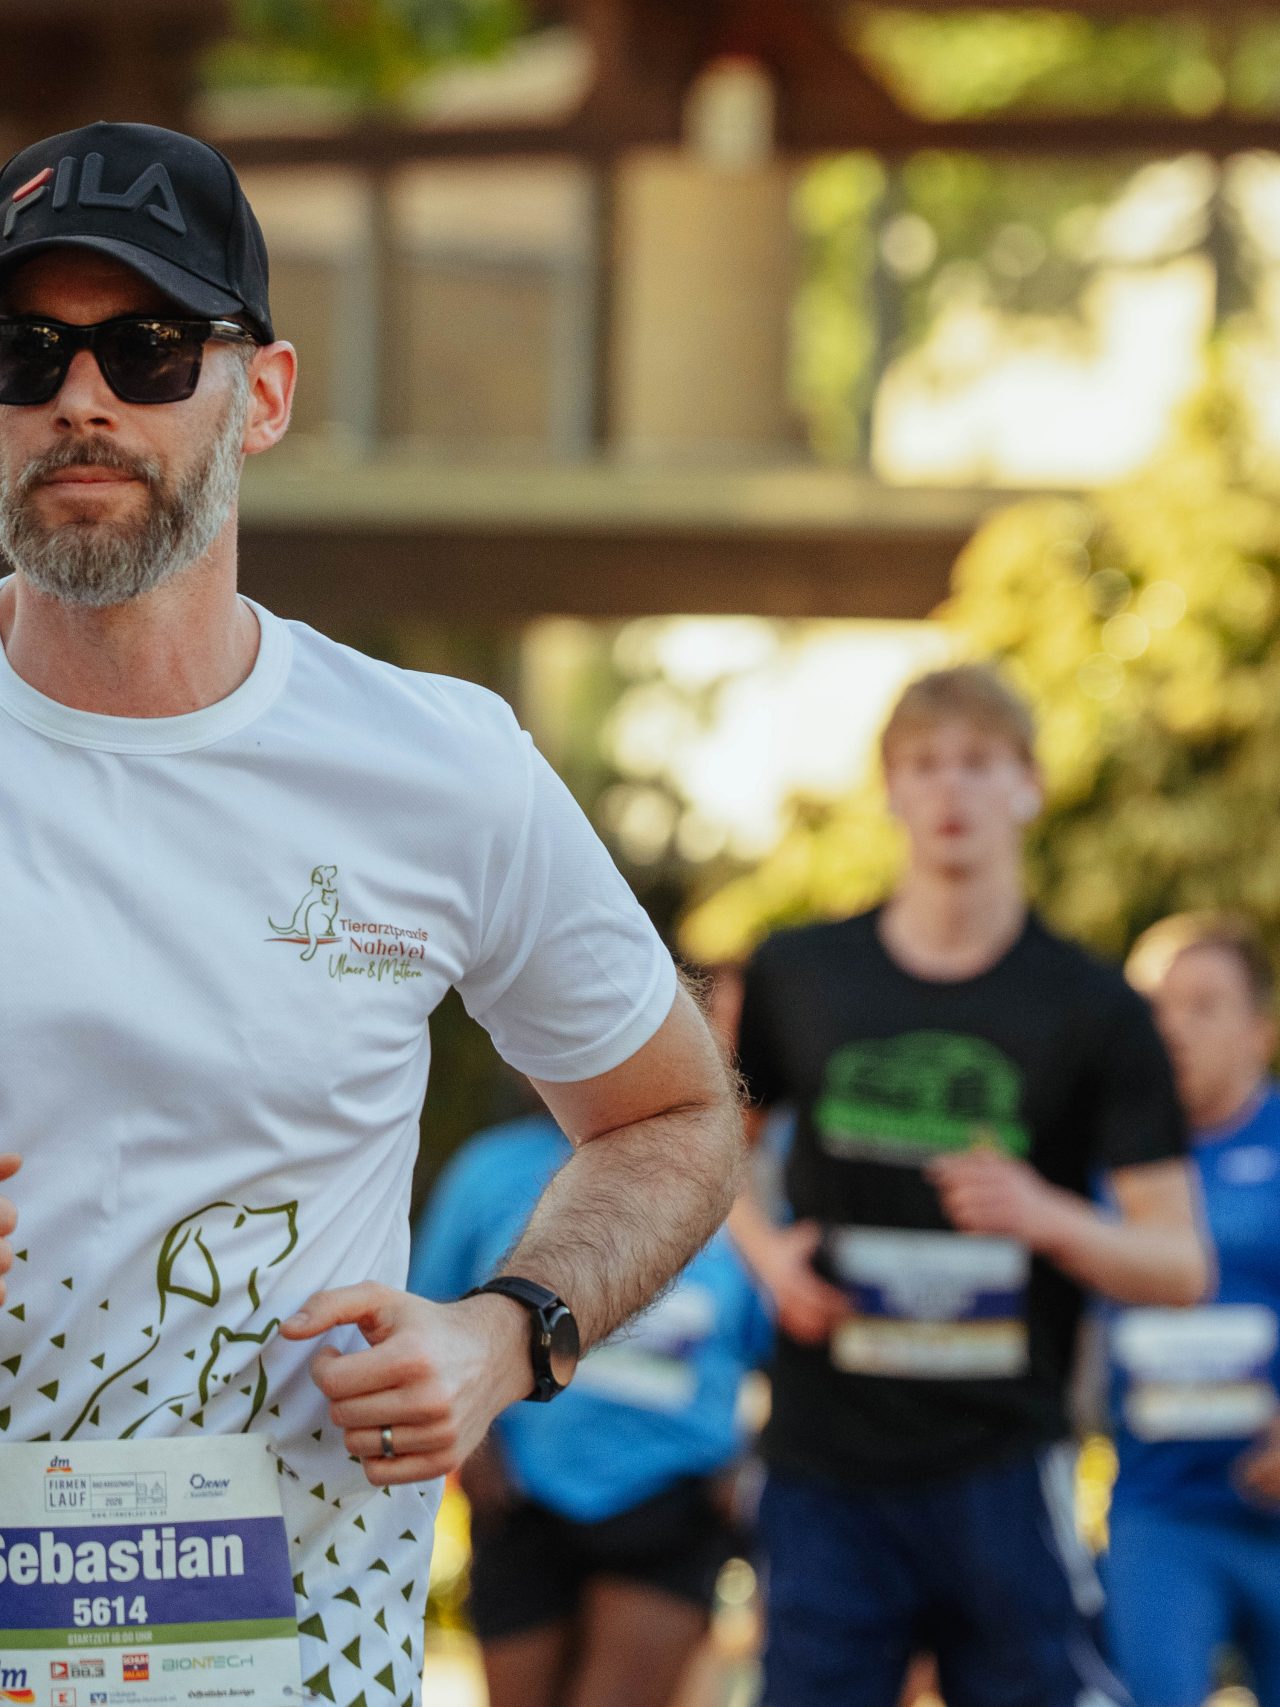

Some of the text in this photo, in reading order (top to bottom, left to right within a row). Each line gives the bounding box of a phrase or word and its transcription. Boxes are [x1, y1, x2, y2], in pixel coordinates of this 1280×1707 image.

[3, 152, 188, 240] FILA
[340, 919, 429, 941] Tierarztpraxis
[367, 960, 376, 978] &
[50, 1454, 70, 1468] dm
[49, 1478, 87, 1490] FIRMEN
[50, 1491, 86, 1508] LAUF
[73, 1595, 148, 1627] 5614
[67, 1631, 110, 1646] STARTZEIT
[135, 1630, 154, 1642] UHR
